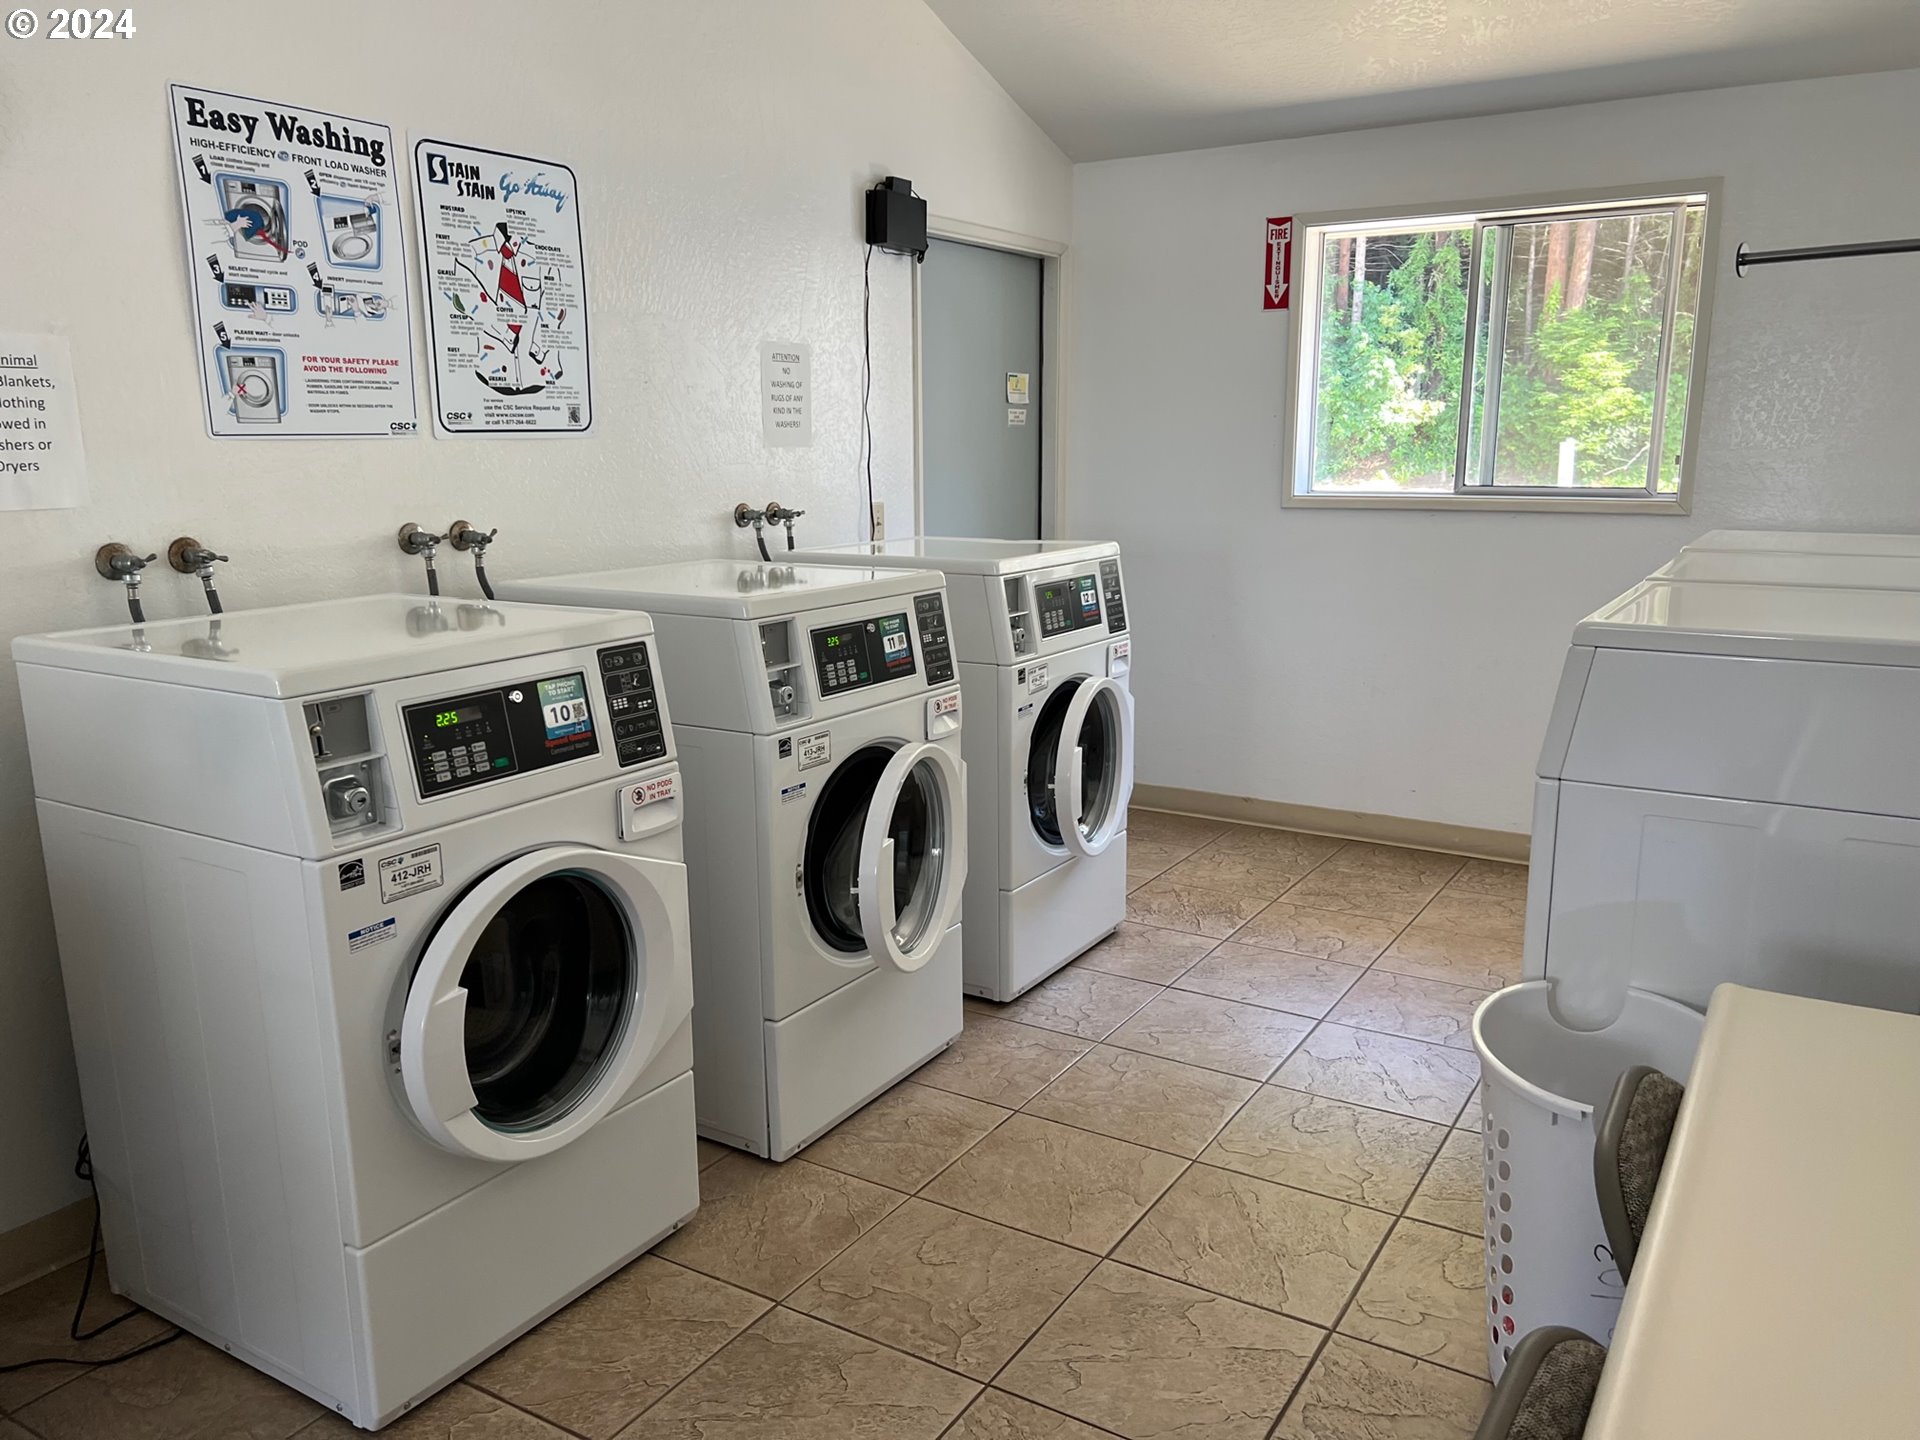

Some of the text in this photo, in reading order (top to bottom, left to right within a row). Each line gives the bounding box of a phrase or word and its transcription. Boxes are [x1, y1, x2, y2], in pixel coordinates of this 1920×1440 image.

[184, 96, 386, 167] Easy Washing
[190, 137, 276, 159] HIGH-EFFICIENCY
[292, 154, 323, 167] FRONT
[325, 158, 349, 172] LOAD
[352, 164, 387, 178] WASHER
[428, 154, 480, 183] STAIN
[310, 179, 317, 188] 2
[457, 180, 495, 200] STAIN
[505, 208, 527, 216] LIPSTICK
[1270, 228, 1288, 240] FIRE
[293, 240, 308, 248] POD
[534, 244, 561, 252] CHOCOLATE
[213, 264, 219, 273] 3
[1274, 241, 1282, 299] EXTINGUISHER
[220, 331, 227, 340] 5
[302, 355, 318, 363] FOR
[319, 356, 340, 364] YOUR
[342, 357, 370, 365] SAFETY
[772, 352, 800, 362] ATTENTION
[782, 367, 791, 375] NO
[771, 380, 803, 389] WASHING OF
[771, 394, 784, 402] RUGS
[785, 394, 792, 402] OF
[446, 412, 466, 420] CSC
[792, 407, 802, 415] THE
[34, 418, 46, 429] in
[390, 422, 411, 430] CSC
[38, 441, 52, 450] or
[887, 636, 896, 650] 11
[544, 679, 577, 691] TAP PHONE
[547, 686, 575, 696] TO START
[436, 711, 458, 727] 2.25
[550, 704, 570, 724] 10
[646, 778, 673, 792] NO PODS
[649, 789, 672, 800] IN TRAY
[381, 858, 397, 868] CSC
[391, 863, 431, 882] 412-JRH
[359, 922, 385, 936] NOTICE
